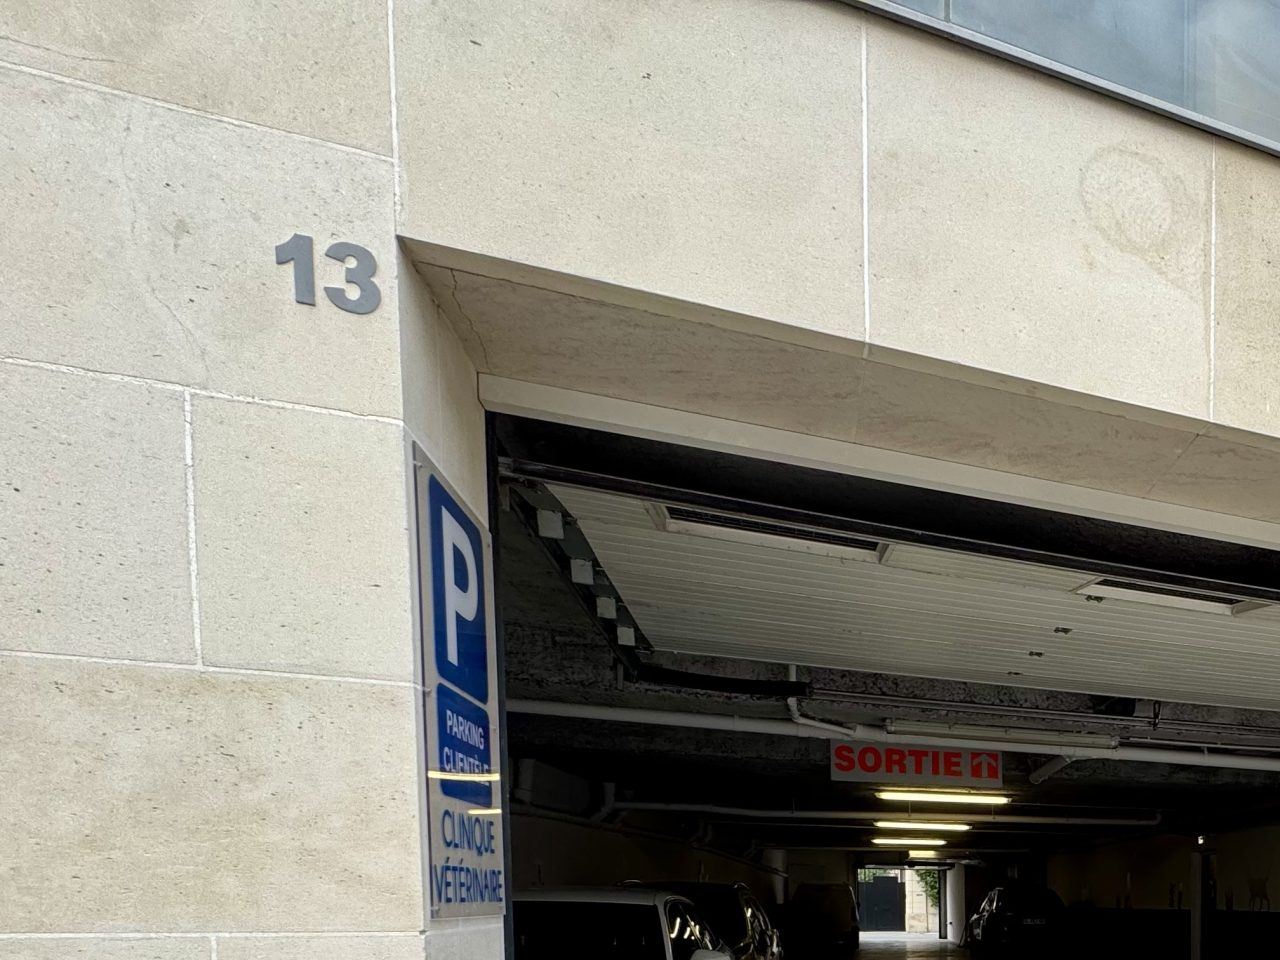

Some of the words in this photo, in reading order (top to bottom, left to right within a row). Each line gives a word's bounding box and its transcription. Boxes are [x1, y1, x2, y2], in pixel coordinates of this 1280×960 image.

[275, 233, 382, 315] 13
[442, 505, 478, 666] P
[446, 709, 485, 750] PARKING
[834, 744, 963, 776] SORTIE
[442, 809, 495, 856] CLINIQUE
[434, 856, 503, 904] VÉTÉRINAIRE
